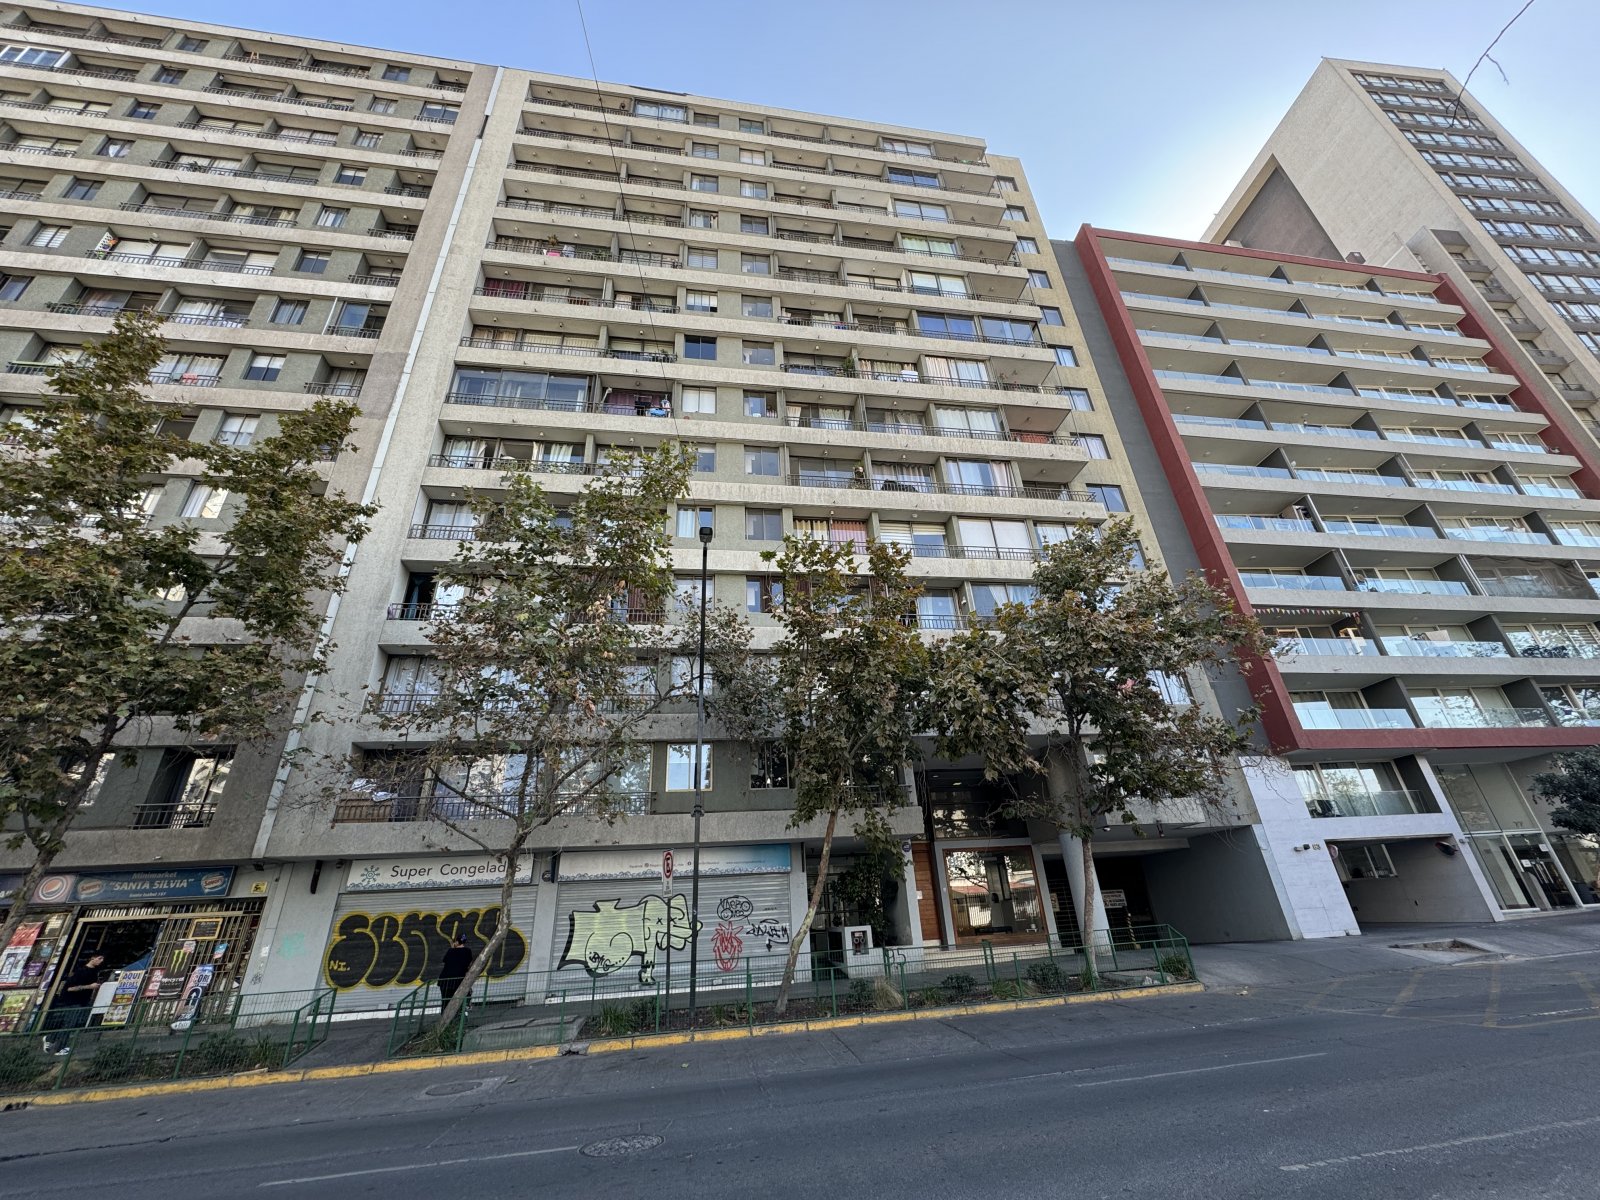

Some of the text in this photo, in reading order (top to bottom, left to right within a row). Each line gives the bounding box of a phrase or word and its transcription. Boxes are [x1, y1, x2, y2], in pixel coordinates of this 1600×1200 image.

[132, 871, 178, 880] Minimarket
[391, 860, 521, 880] Super Congelads
